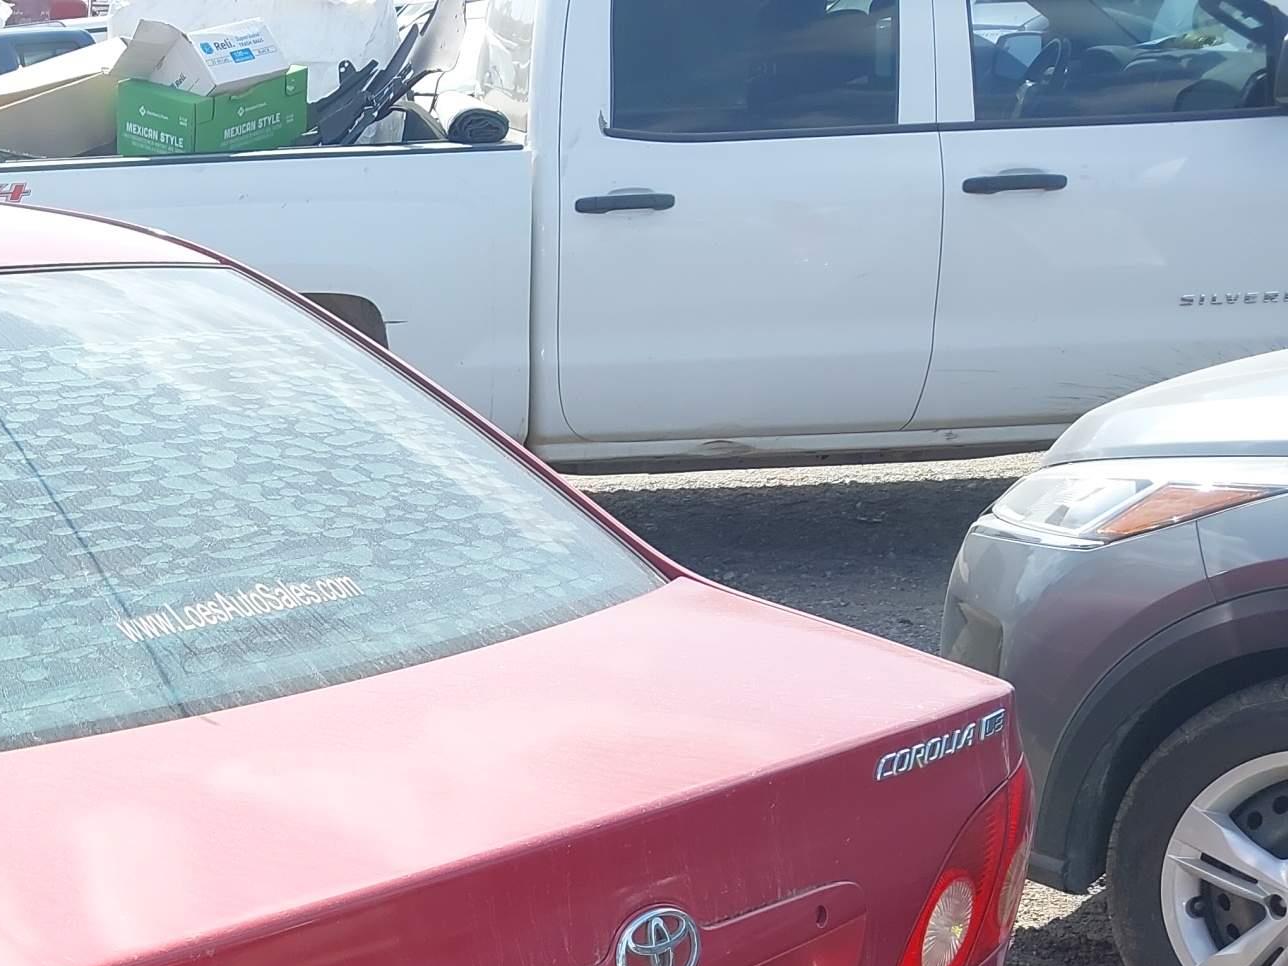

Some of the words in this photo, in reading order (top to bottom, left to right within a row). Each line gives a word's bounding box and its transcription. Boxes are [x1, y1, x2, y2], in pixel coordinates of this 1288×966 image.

[126, 122, 159, 141] MEXICAN
[159, 133, 184, 148] STYLE
[223, 121, 256, 140] MEXICAN
[257, 112, 281, 130] STYLE
[117, 575, 364, 643] www.LoesAutoSales.com
[875, 722, 976, 781] COROLLA
[981, 709, 1006, 740] LE
